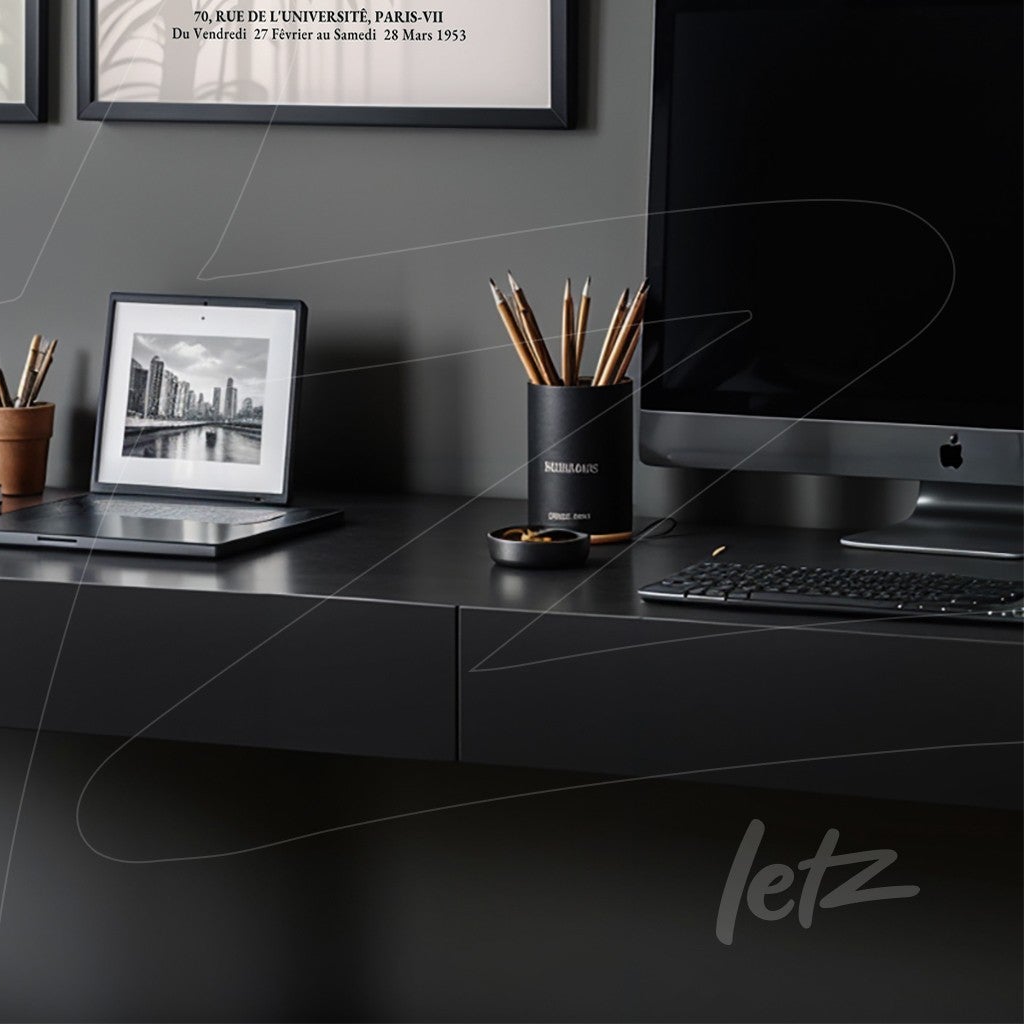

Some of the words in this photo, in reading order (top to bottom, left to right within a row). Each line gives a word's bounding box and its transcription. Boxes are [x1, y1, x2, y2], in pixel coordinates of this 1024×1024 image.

[193, 10, 213, 25] 70,
[215, 10, 245, 23] RUE
[247, 10, 267, 23] DE
[374, 10, 444, 24] PARIS-VII
[171, 27, 191, 41] Du
[193, 26, 248, 41] Vendredi
[253, 27, 270, 41] 27
[316, 31, 331, 42] au
[333, 27, 377, 42] Samedi
[383, 27, 400, 42] 28
[402, 27, 434, 42] Mars
[436, 28, 468, 43] 1953
